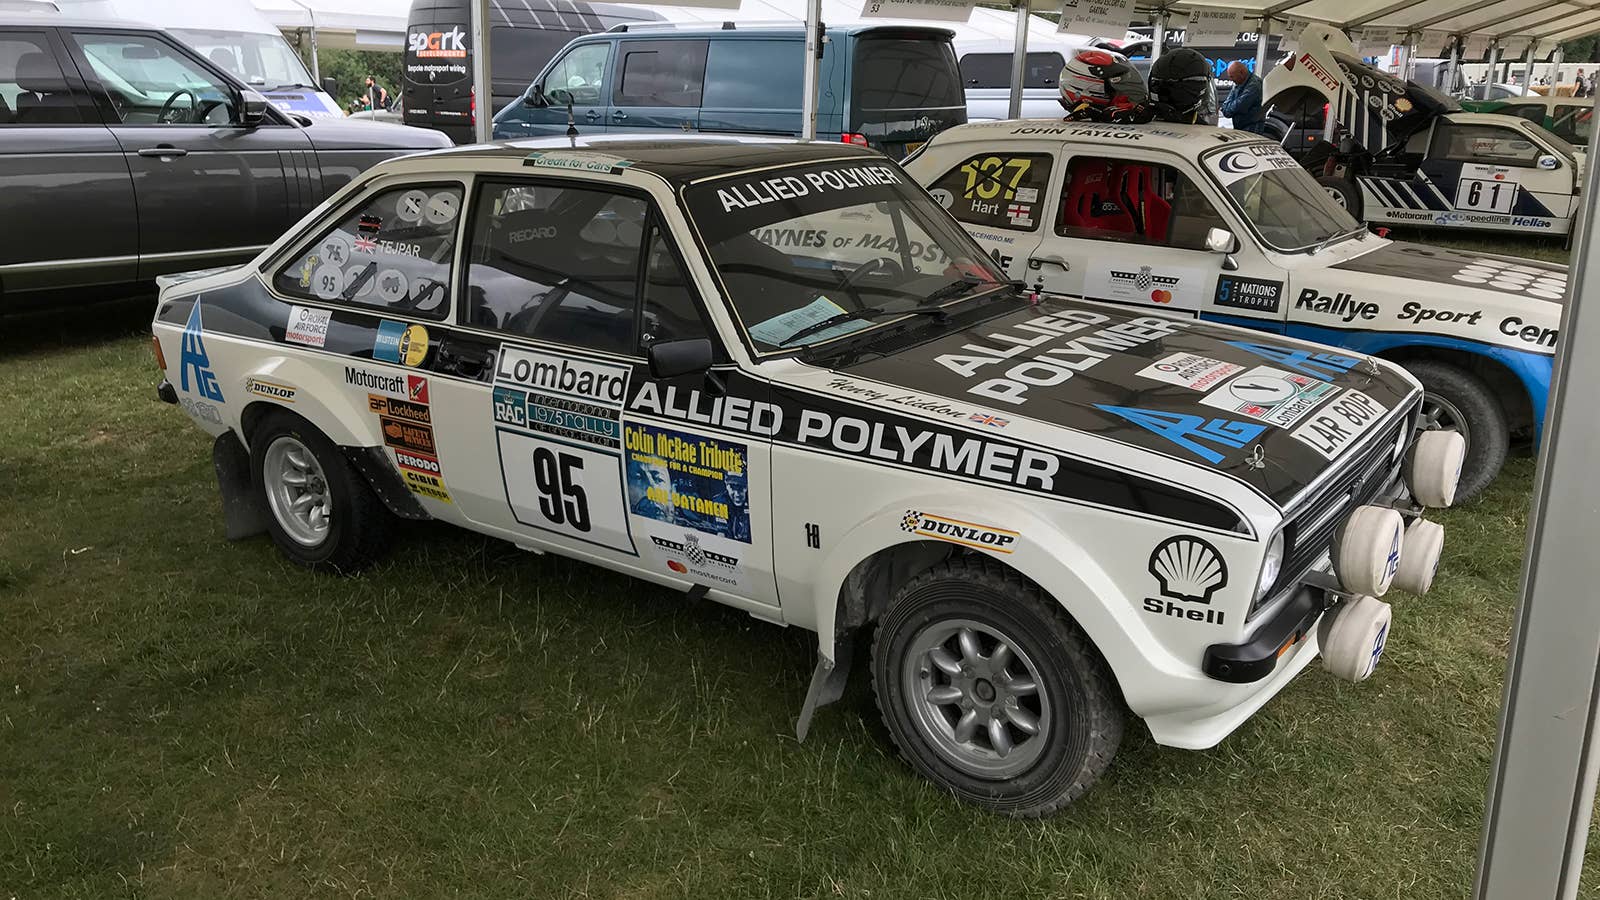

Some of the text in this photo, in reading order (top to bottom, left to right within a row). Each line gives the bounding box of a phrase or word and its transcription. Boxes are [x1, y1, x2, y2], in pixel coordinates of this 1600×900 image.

[1299, 53, 1339, 91] PIRELLI
[1010, 126, 1145, 141] JOHN TAYLOR
[716, 166, 903, 214] ALLIED POLYMER
[1467, 181, 1501, 209] 61
[970, 199, 1000, 216] Hart
[1391, 211, 1434, 222] Motorcraft
[1511, 216, 1545, 228] Hella
[379, 238, 422, 259] TEJPAR
[508, 225, 558, 244] RECARO
[321, 274, 336, 292] 95
[1219, 279, 1278, 301] 5 NATIONS
[1238, 295, 1276, 308] TROPHY
[1294, 287, 1380, 322] Rallye
[1397, 301, 1482, 326] Sport
[286, 331, 325, 345] motorsports
[933, 309, 1111, 378] ALLIED
[966, 316, 1191, 405] POLYMER
[344, 366, 405, 395] Motorcraft
[495, 348, 630, 402] Lombard
[253, 382, 296, 400] DUNLOP
[825, 377, 967, 419] Henry Liddon
[388, 400, 430, 422] Lockheed
[494, 401, 525, 426] RAC
[628, 381, 1061, 492] ALLIED POLYMER
[1297, 416, 1353, 455] LAR
[397, 452, 439, 473] FERODO
[624, 425, 655, 456] Colin
[656, 431, 697, 464] McRae
[698, 440, 744, 475] Tribute
[532, 446, 592, 533] 95
[920, 518, 1015, 547] DUNLOP
[689, 567, 738, 587] mastercard
[1143, 597, 1225, 625] Shell
